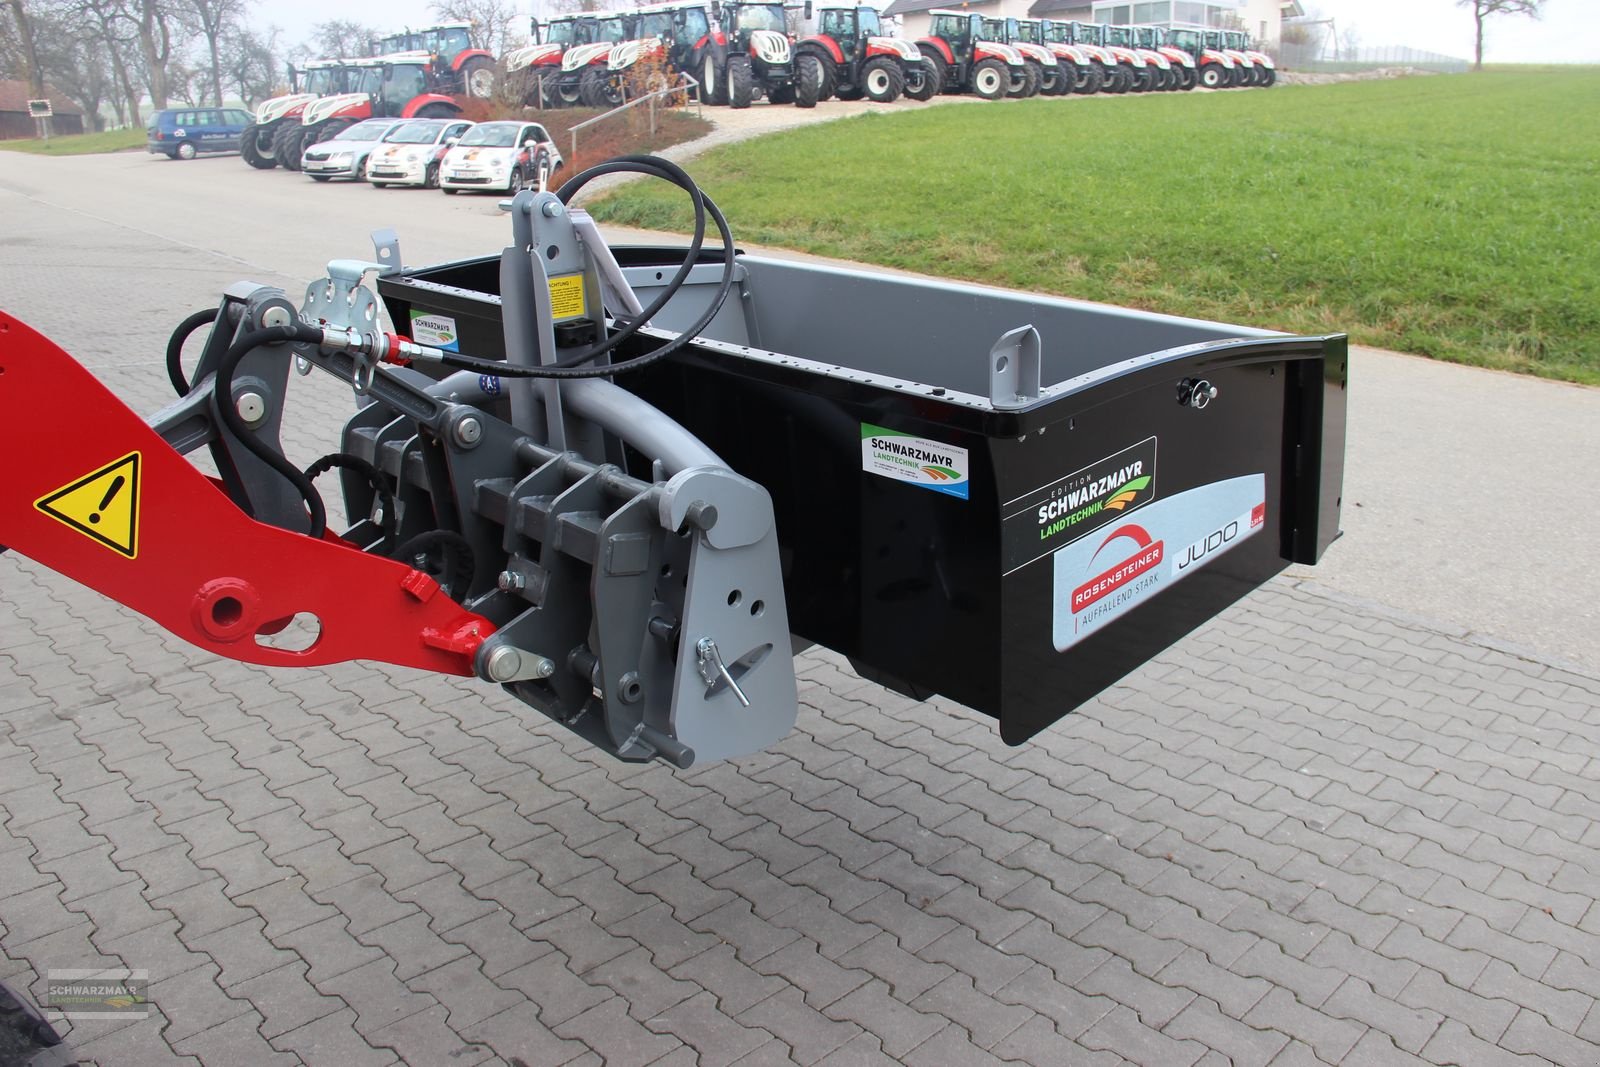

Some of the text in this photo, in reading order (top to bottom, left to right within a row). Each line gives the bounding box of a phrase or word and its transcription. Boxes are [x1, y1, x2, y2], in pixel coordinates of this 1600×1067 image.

[415, 318, 450, 332] SCHWARZMAYR
[871, 438, 953, 468] SCHWARZMAYR
[873, 451, 920, 470] LANDTECHNIK
[1038, 460, 1143, 525] SCHWARZMAYR
[1051, 474, 1091, 498] EDITION
[1040, 500, 1104, 540] LANDTECHNIK
[1178, 520, 1238, 570] JUDO
[1075, 549, 1160, 606] ROSENSTEINER
[1082, 574, 1159, 627] AUFFALLEND STARK
